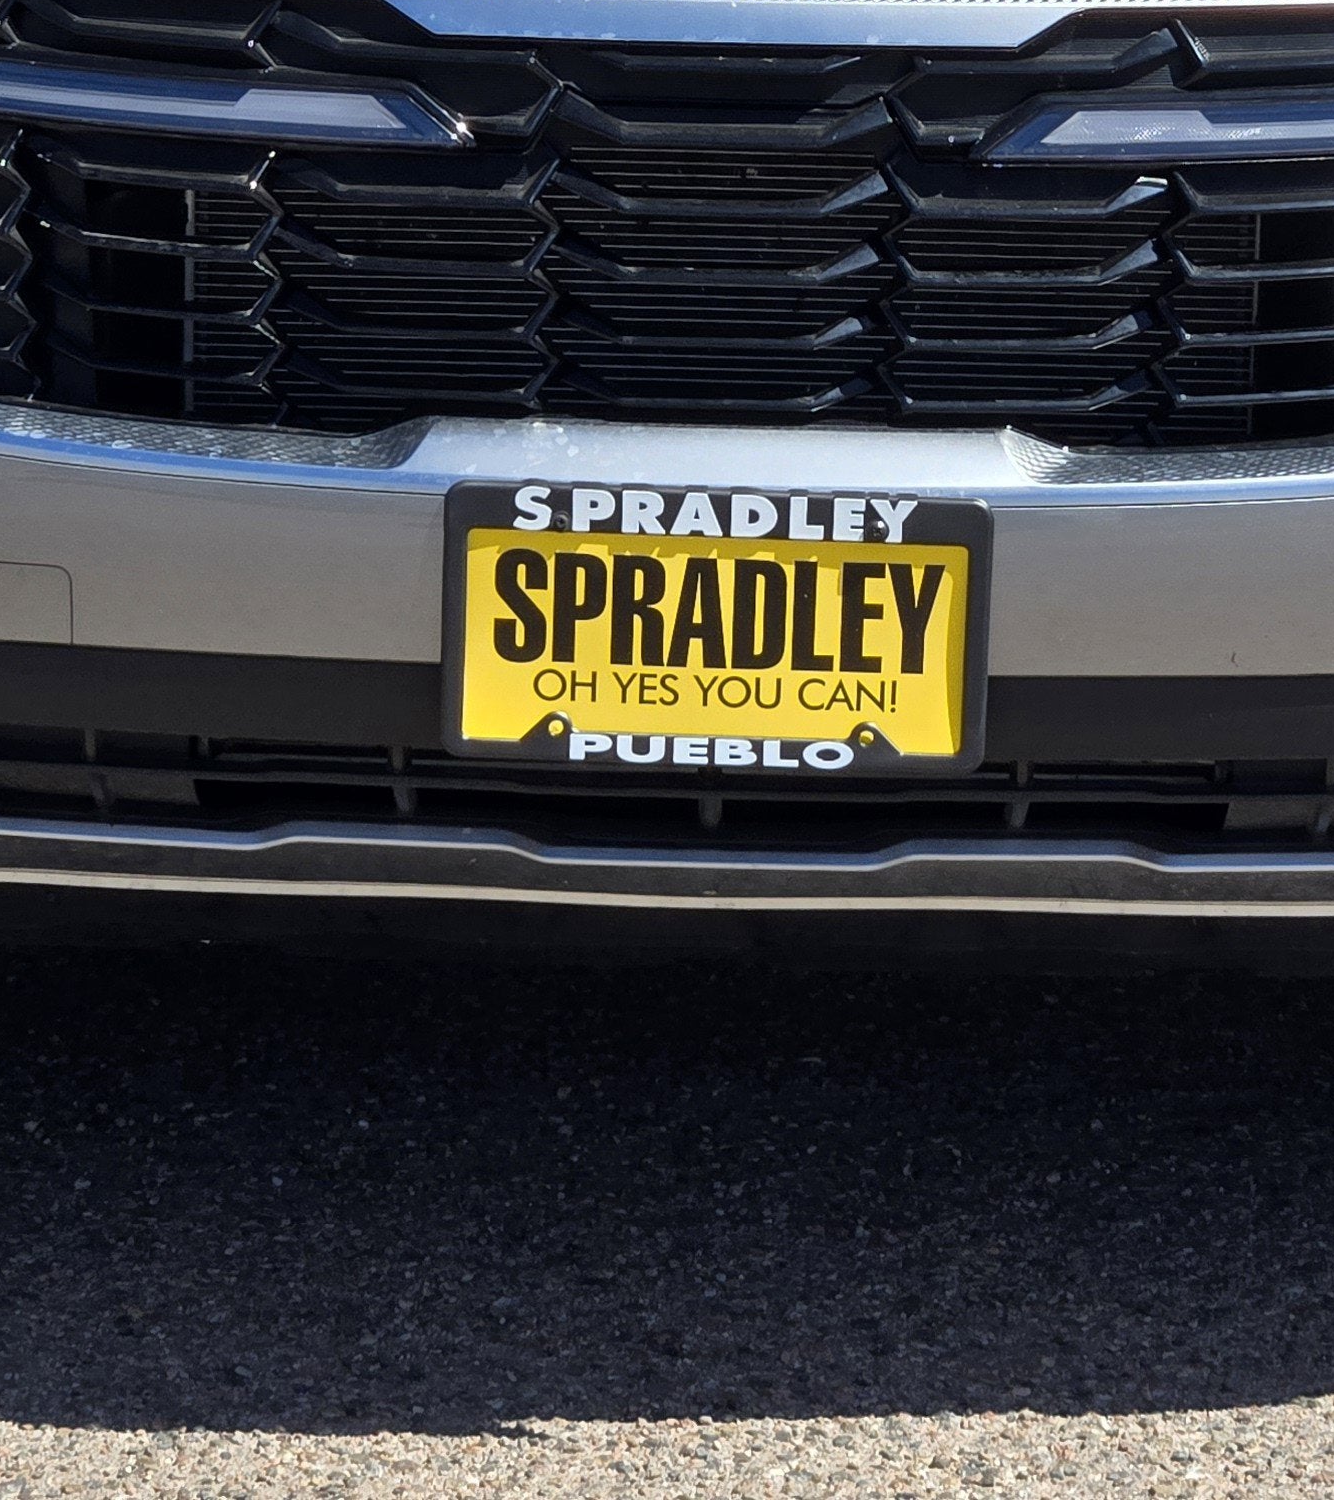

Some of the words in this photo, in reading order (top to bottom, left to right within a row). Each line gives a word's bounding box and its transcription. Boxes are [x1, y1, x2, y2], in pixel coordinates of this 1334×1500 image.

[493, 548, 946, 675] SPRADLEY
[533, 669, 597, 703] OH
[613, 672, 679, 706] YES
[694, 675, 782, 710] YOU
[797, 678, 898, 713] CAN!
[568, 734, 855, 770] PUEBLO
